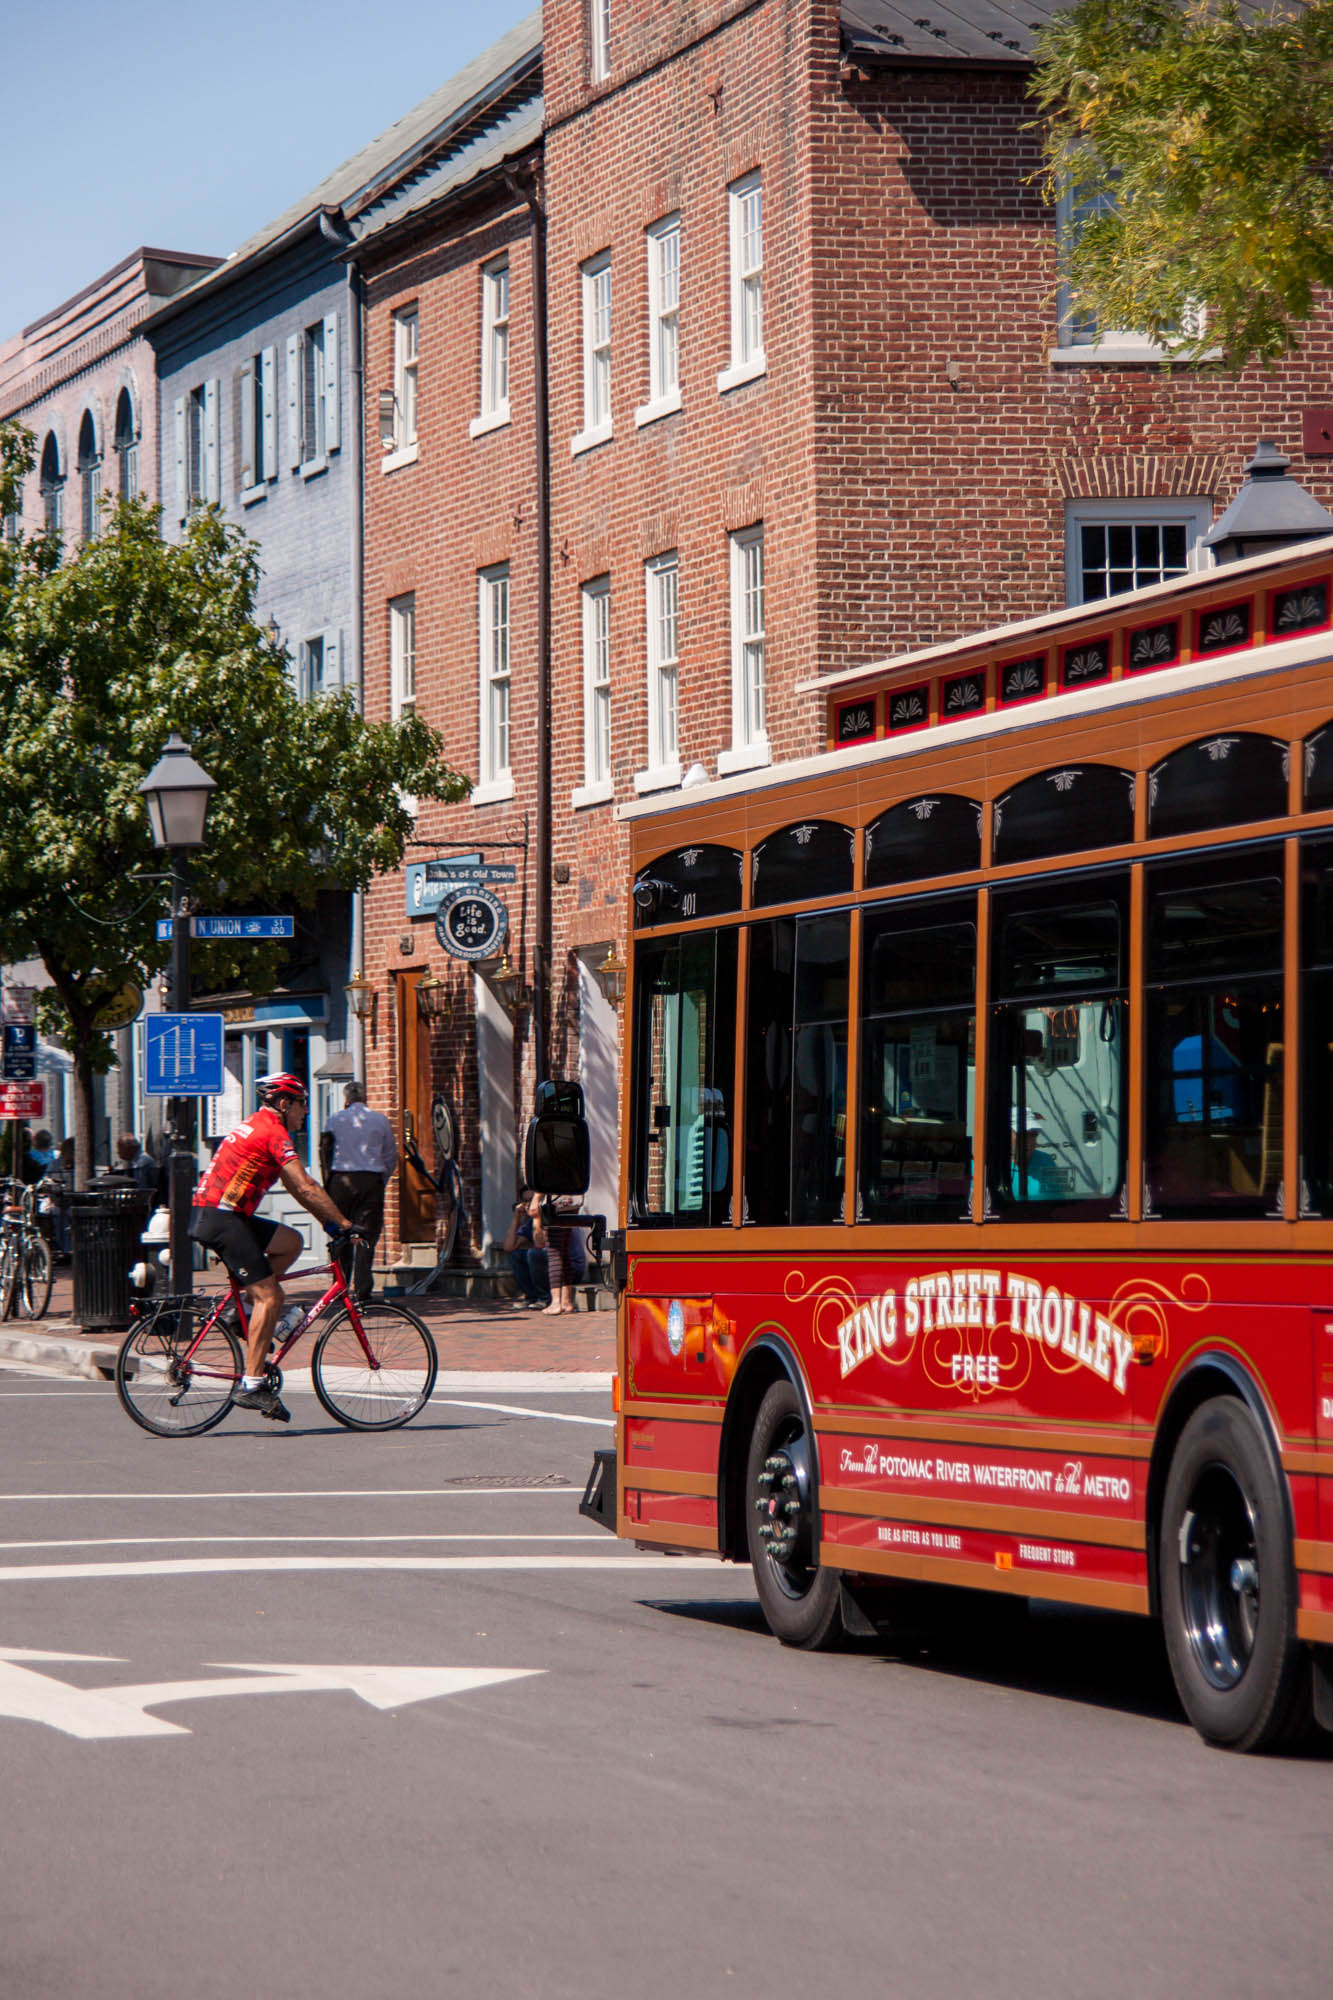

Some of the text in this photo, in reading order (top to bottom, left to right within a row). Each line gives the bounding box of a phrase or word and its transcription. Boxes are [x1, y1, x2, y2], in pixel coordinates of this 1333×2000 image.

[459, 870, 470, 879] of
[473, 868, 488, 879] Old
[490, 870, 514, 879] Town
[461, 904, 482, 918] Life
[682, 893, 696, 916] 401
[198, 920, 206, 935] N
[211, 920, 241, 935] UNION
[272, 927, 285, 935] 100
[467, 916, 477, 925] is
[838, 1269, 1133, 1395] KING STREET TROLLEY
[952, 1354, 999, 1382] FREE
[840, 1449, 864, 1473] From
[880, 1456, 933, 1480] POTOMAC
[935, 1458, 970, 1483] RIVER
[973, 1464, 1053, 1491] WATERFRONT
[1055, 1473, 1064, 1493] to
[1084, 1475, 1130, 1500] METRO
[878, 1527, 961, 1549] RIDE AS OFTEN AS YOU LIKE!
[1019, 1543, 1075, 1566] FREQUENT STOPS
